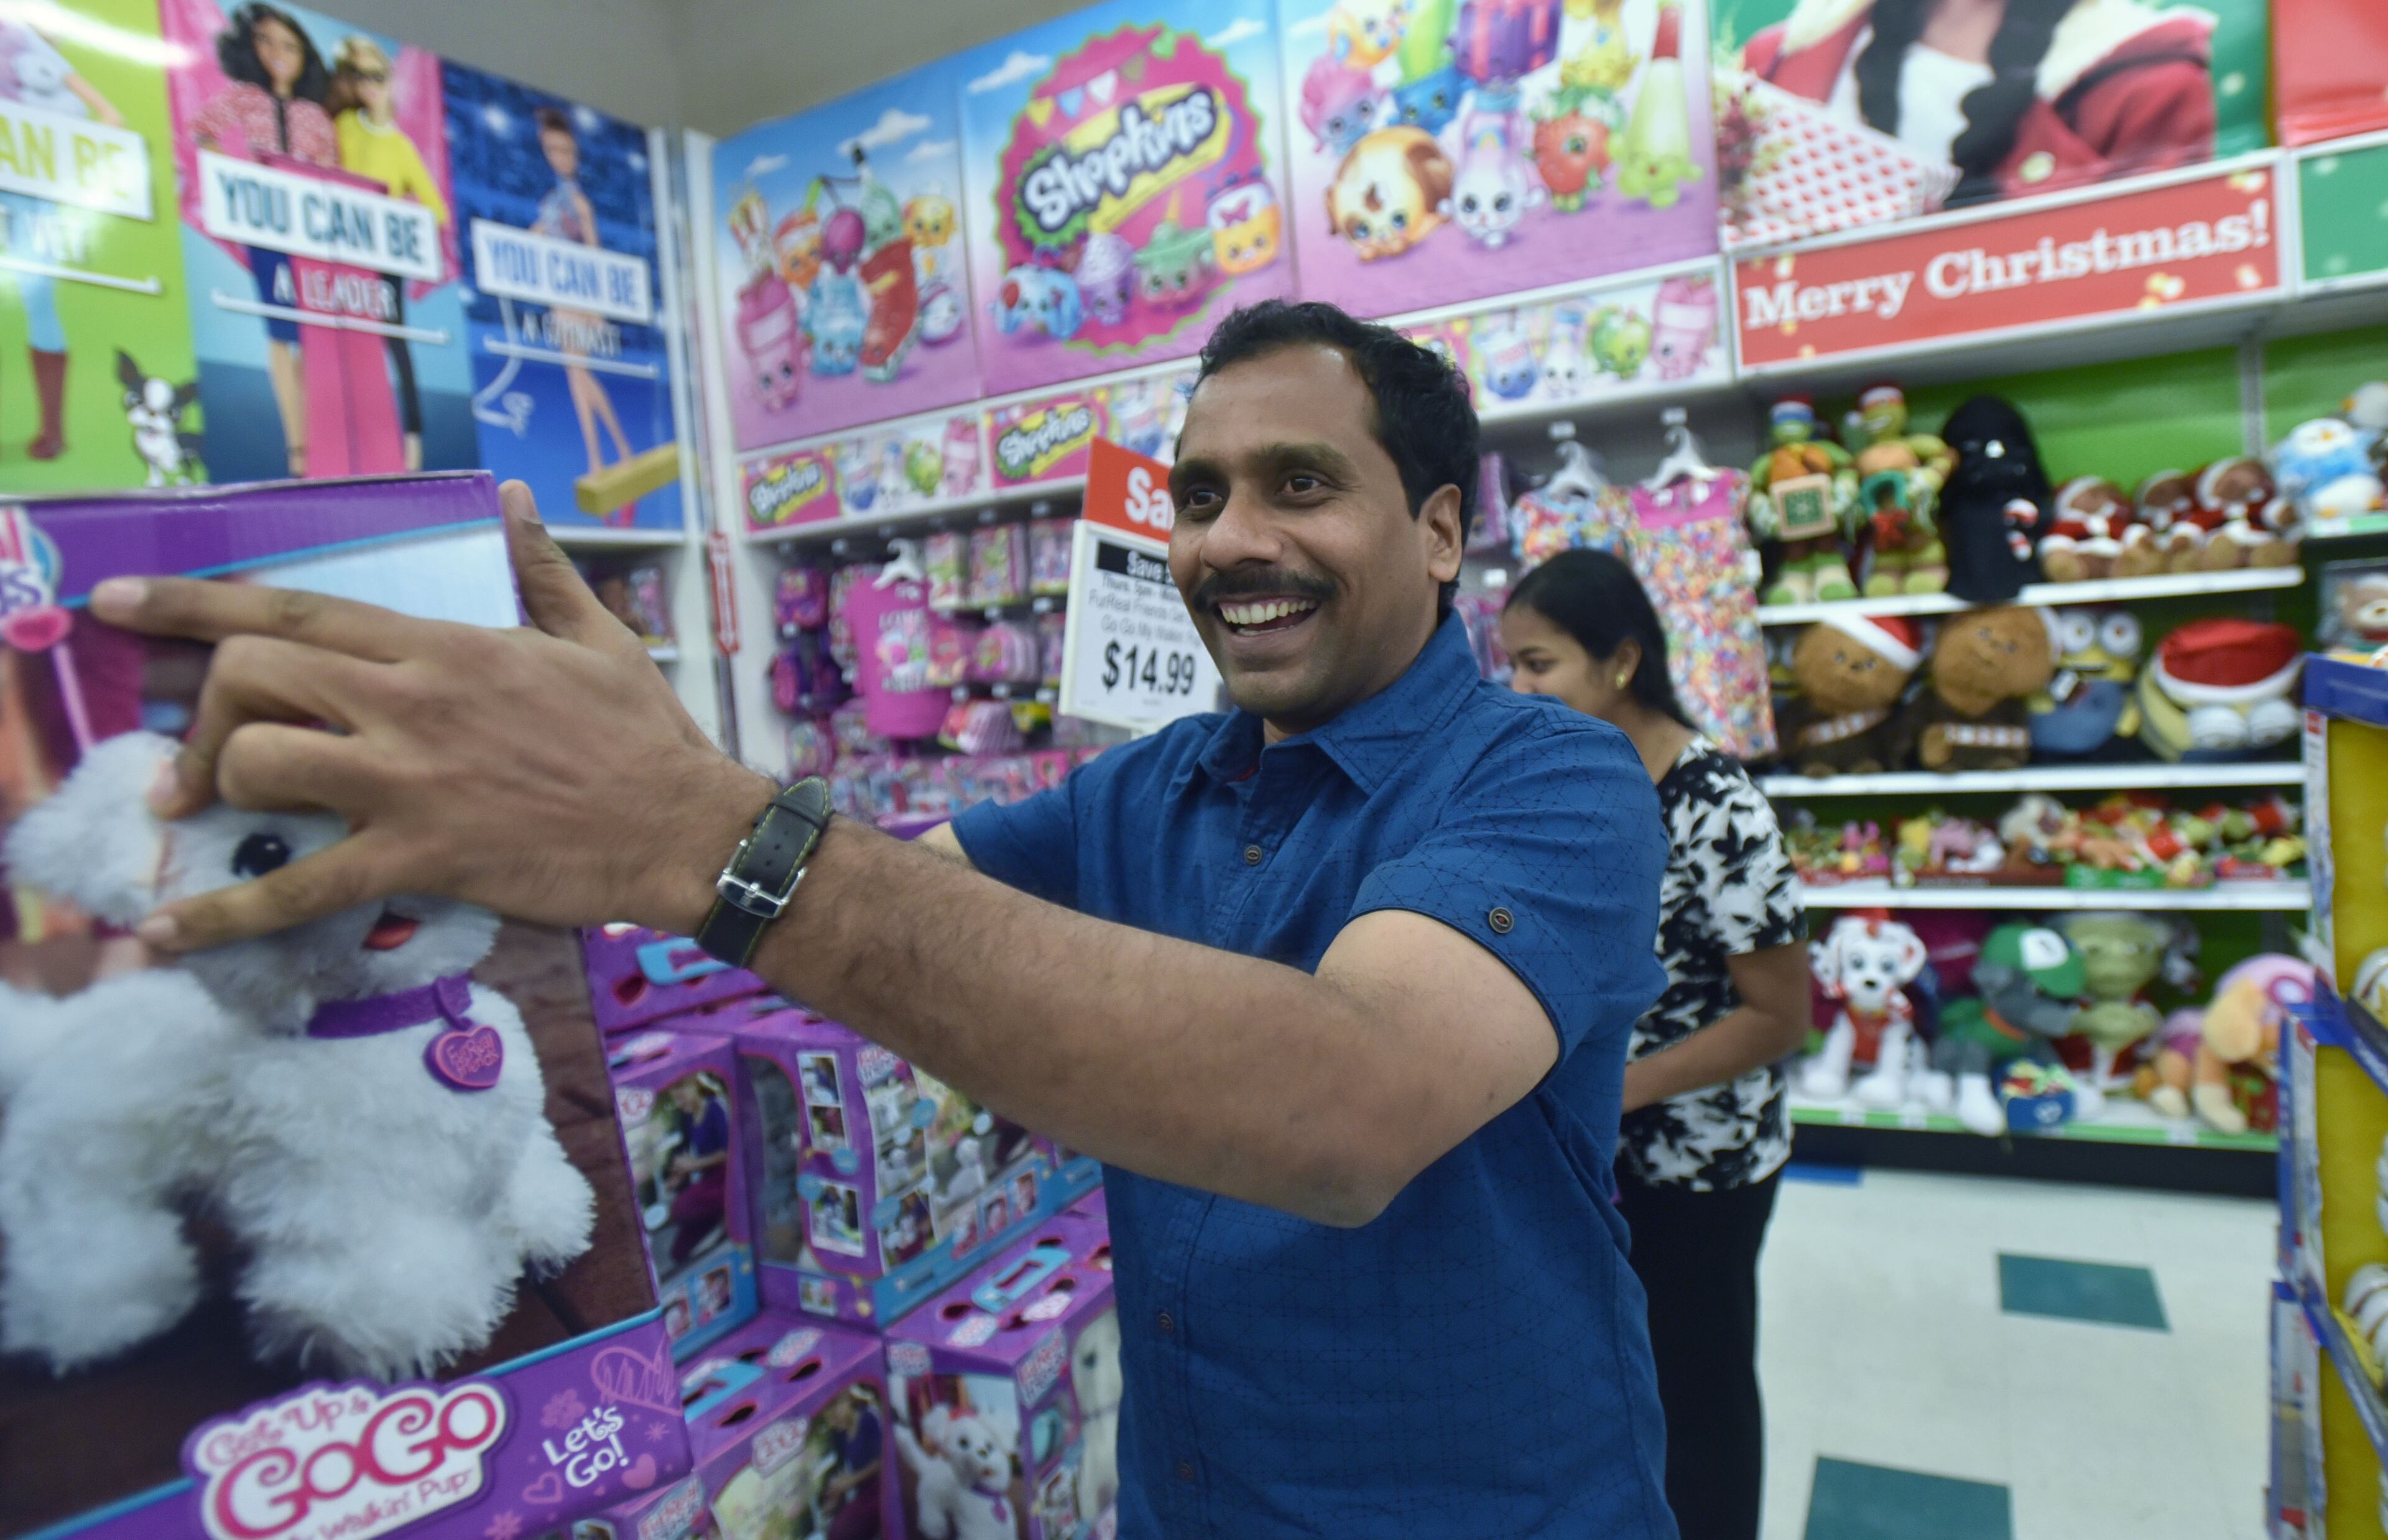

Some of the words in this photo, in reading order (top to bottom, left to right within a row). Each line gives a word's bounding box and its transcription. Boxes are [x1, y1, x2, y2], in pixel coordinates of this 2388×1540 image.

[1025, 92, 1214, 228] Shopkins
[218, 168, 290, 234] YOU
[303, 190, 376, 250] CAN
[384, 208, 423, 264] BE
[274, 262, 297, 305] A
[301, 267, 398, 321] LEADER
[547, 249, 601, 300] CAN
[607, 262, 638, 310] BE
[1744, 266, 1915, 330] Merry
[1923, 199, 2271, 300] Christmas!
[1126, 549, 1165, 582] Save
[1101, 637, 1195, 697] $14.99
[283, 1398, 344, 1431] Up
[542, 1406, 624, 1466] Let's
[416, 1467, 471, 1504] Pup
[565, 1432, 629, 1488] Go!
